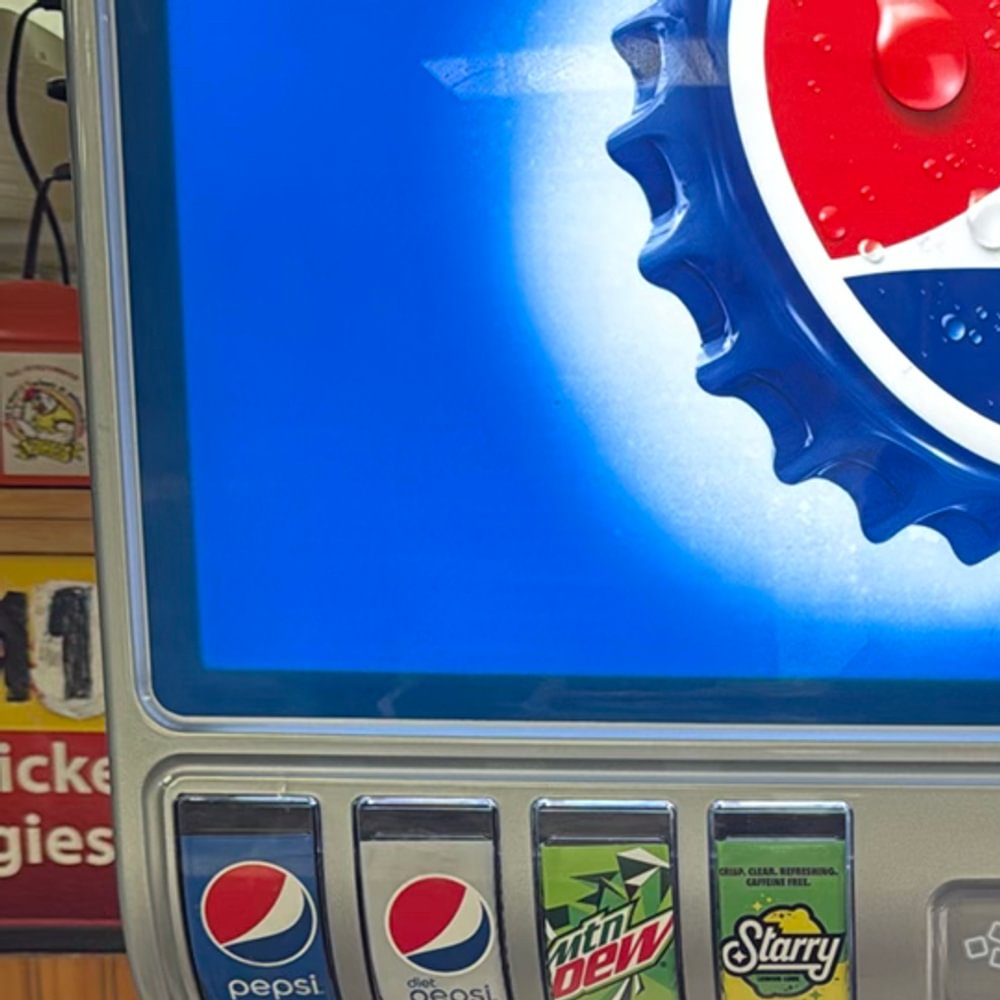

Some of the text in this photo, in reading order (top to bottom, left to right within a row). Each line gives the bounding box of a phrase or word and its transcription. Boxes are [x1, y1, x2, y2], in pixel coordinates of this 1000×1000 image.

[722, 918, 841, 982] Starry
[228, 973, 320, 1000] pepsi
[407, 976, 437, 988] diet
